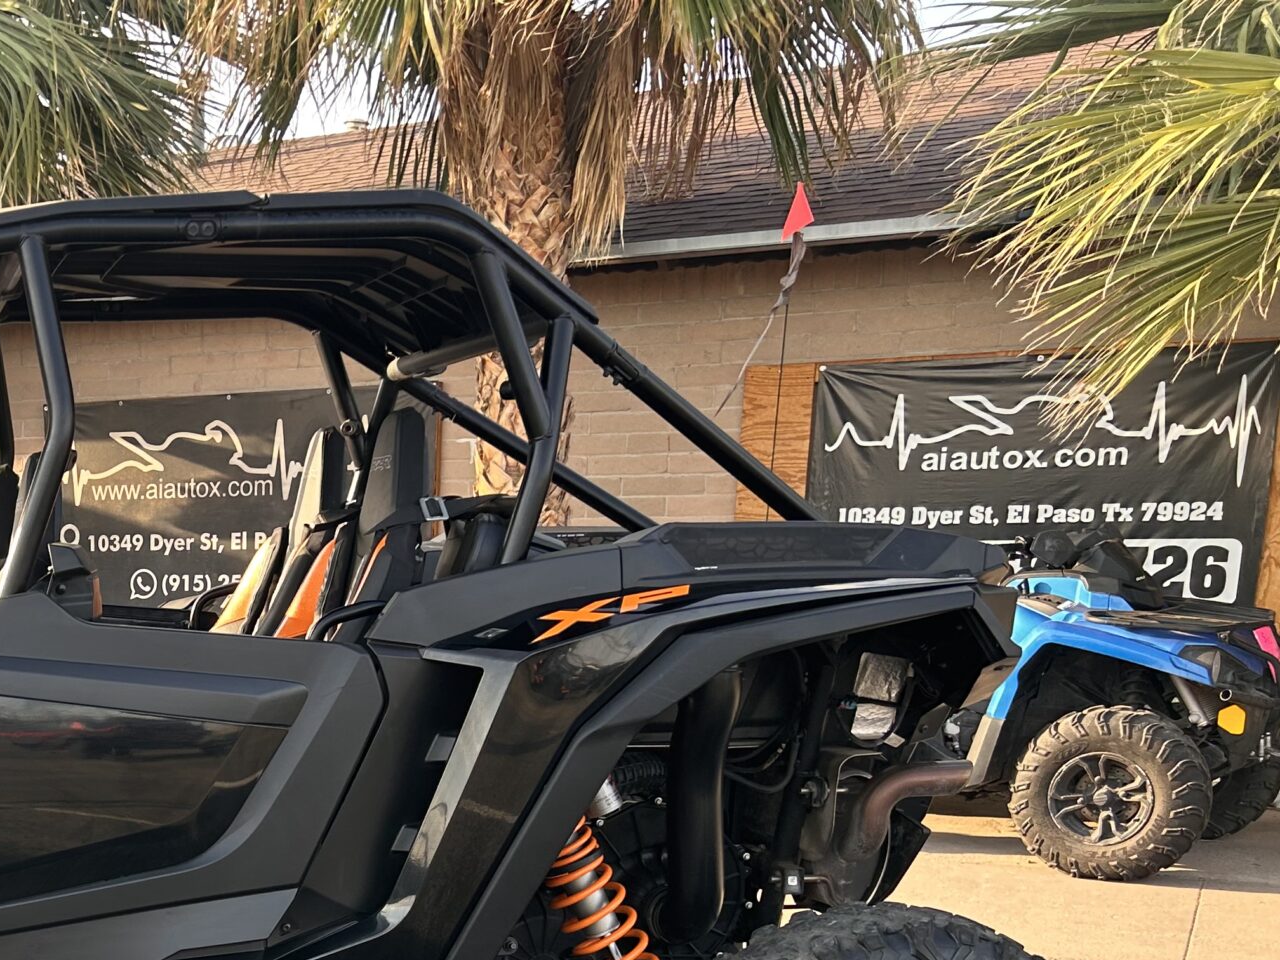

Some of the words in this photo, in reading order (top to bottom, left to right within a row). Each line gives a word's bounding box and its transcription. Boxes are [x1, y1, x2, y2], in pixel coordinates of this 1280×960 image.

[920, 445, 1129, 472] aiautox.com
[91, 477, 274, 501] www.aiautox.com
[838, 506, 906, 526] 10349
[911, 505, 964, 530] Dyer
[968, 504, 1000, 527] St,
[1006, 504, 1031, 525] El
[1036, 503, 1095, 524] Paso
[1101, 502, 1134, 523] Tx
[1140, 501, 1224, 522] 79924
[87, 533, 144, 552] 10349
[149, 532, 195, 556] Dyer
[199, 532, 225, 554] St,
[230, 530, 248, 551] El
[161, 573, 212, 596] (915)
[1128, 544, 1230, 600] 26
[528, 584, 690, 645] XP
